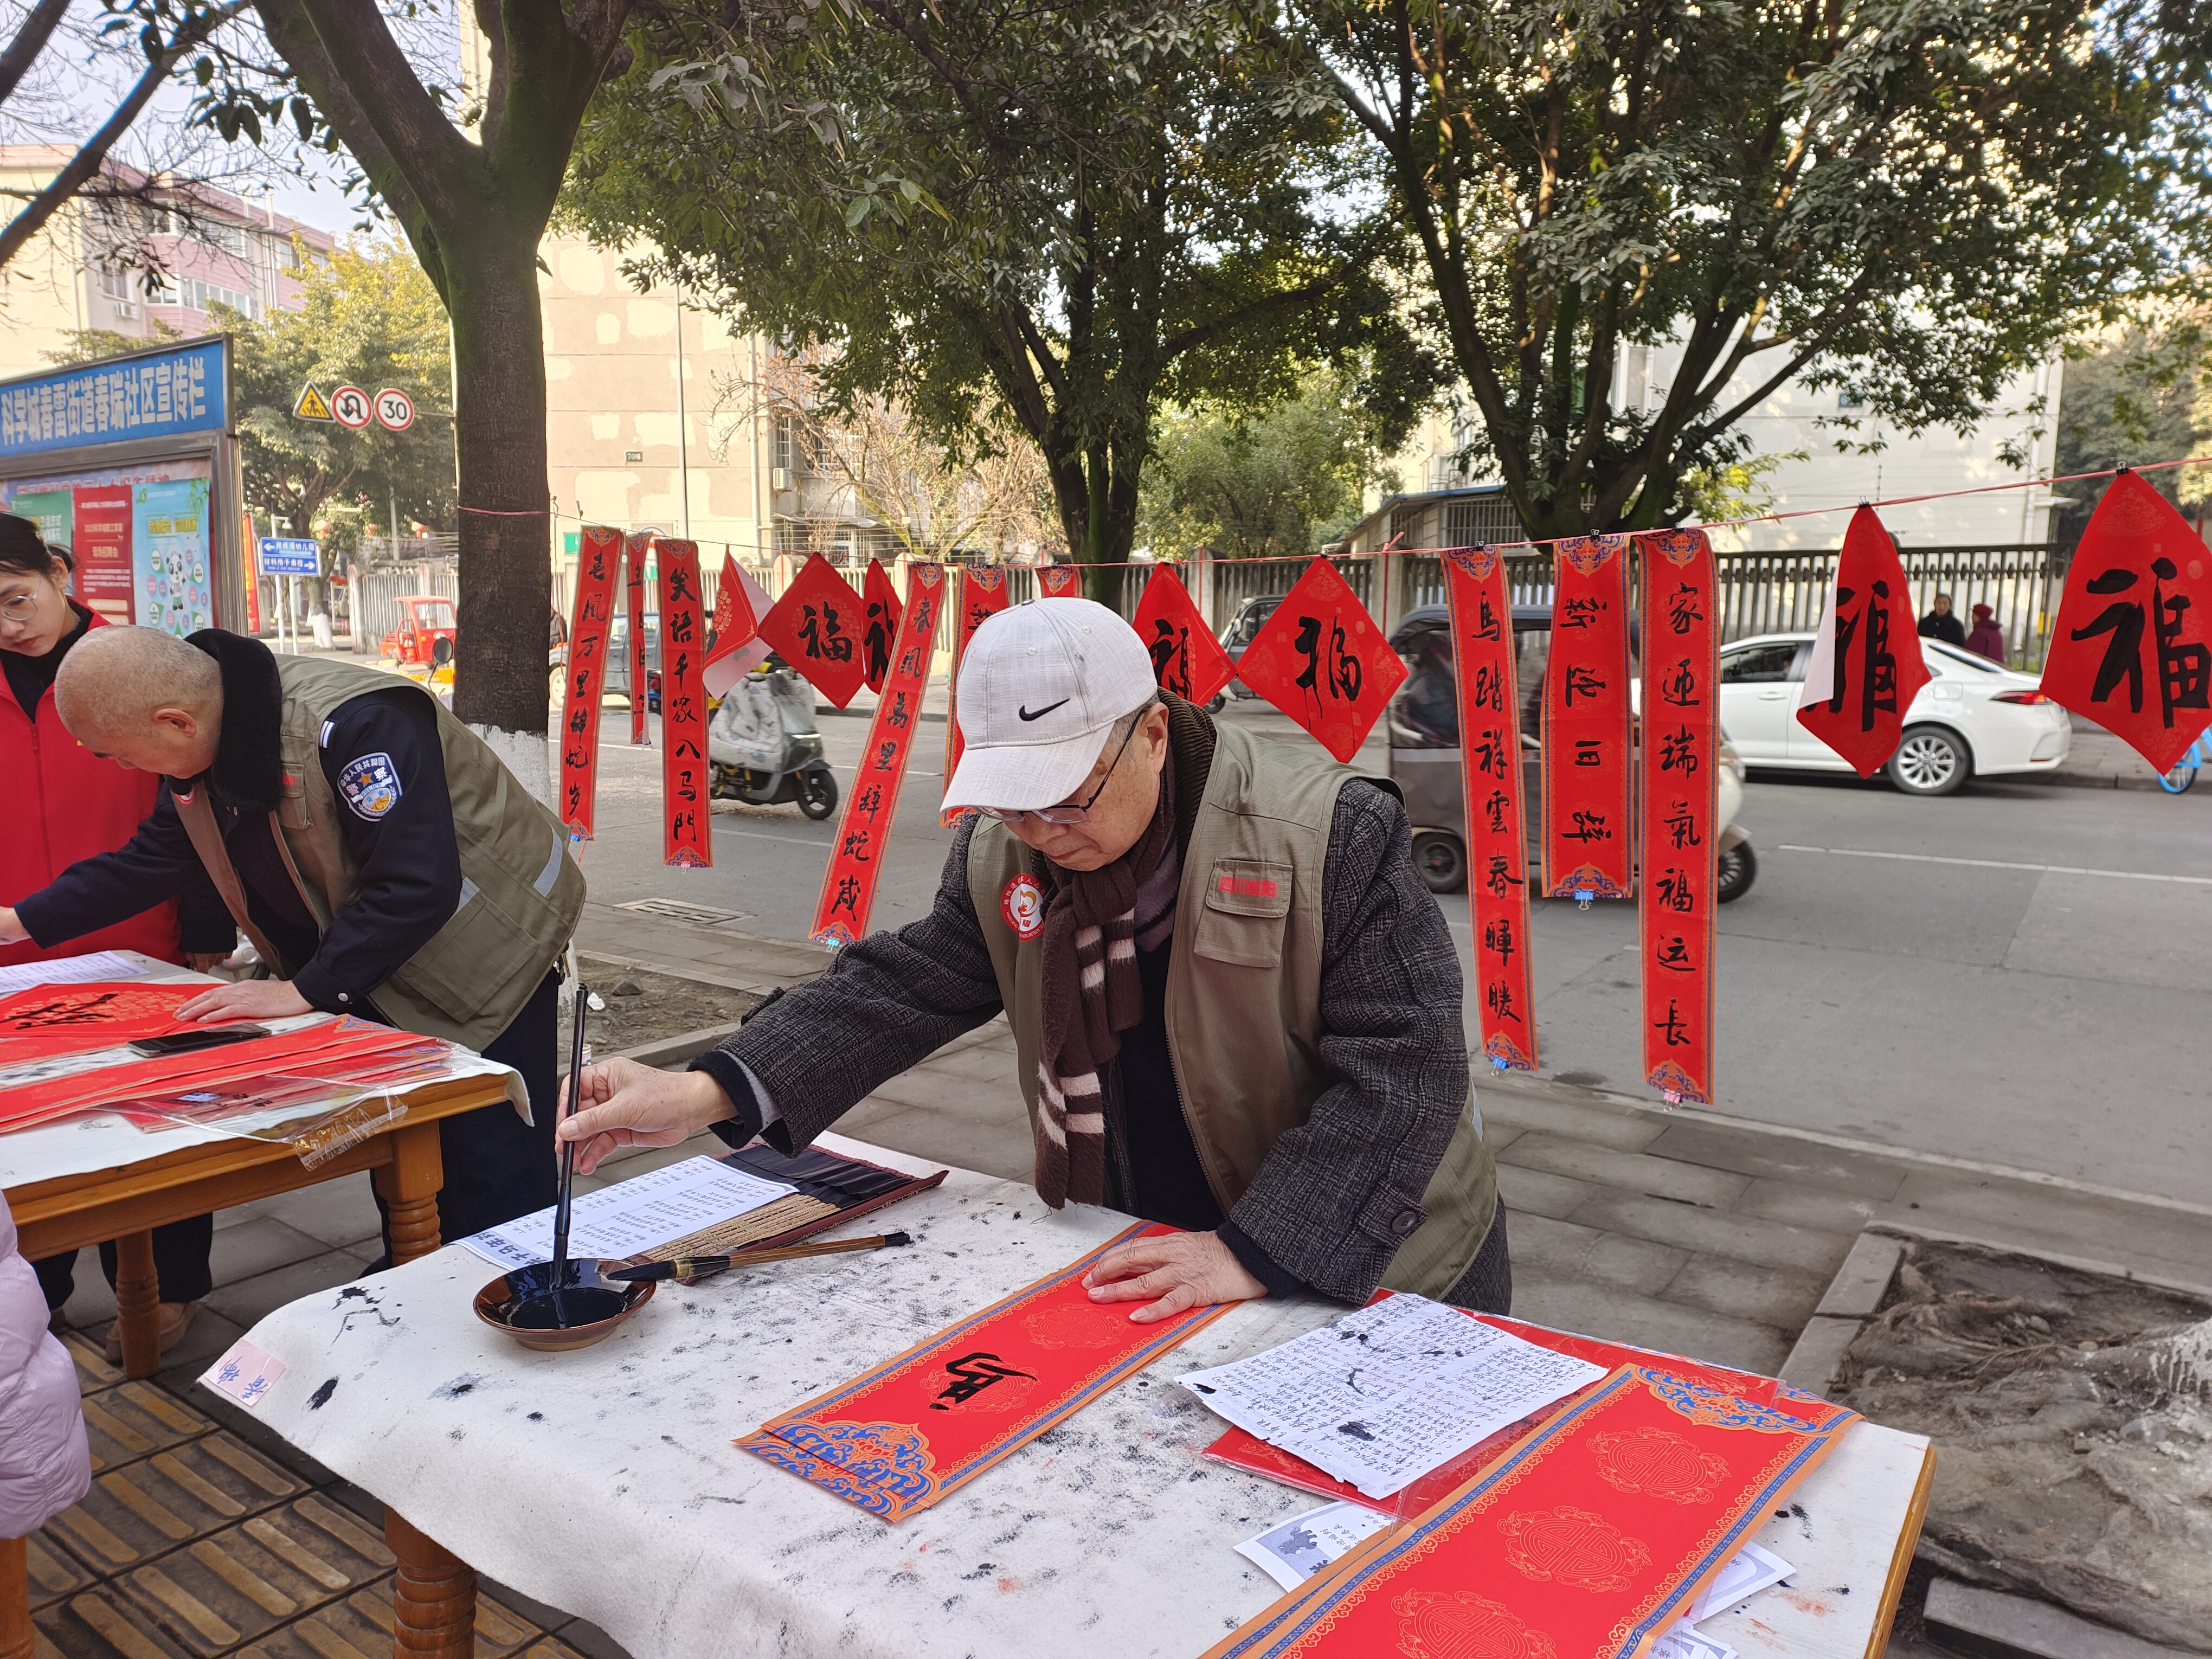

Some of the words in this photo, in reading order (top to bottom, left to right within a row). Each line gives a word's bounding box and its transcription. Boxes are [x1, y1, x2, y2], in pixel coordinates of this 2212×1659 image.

[1, 357, 206, 446] 科学城春雷街道春瑞社区宣传栏
[383, 400, 407, 420] 30
[798, 600, 852, 664] 福
[2070, 557, 2211, 729] 福
[339, 756, 385, 788] 中华人民共和国
[360, 783, 382, 798] POLICE
[1218, 876, 1277, 898] 四川绵阳
[1005, 910, 1018, 928] MIANYANG
